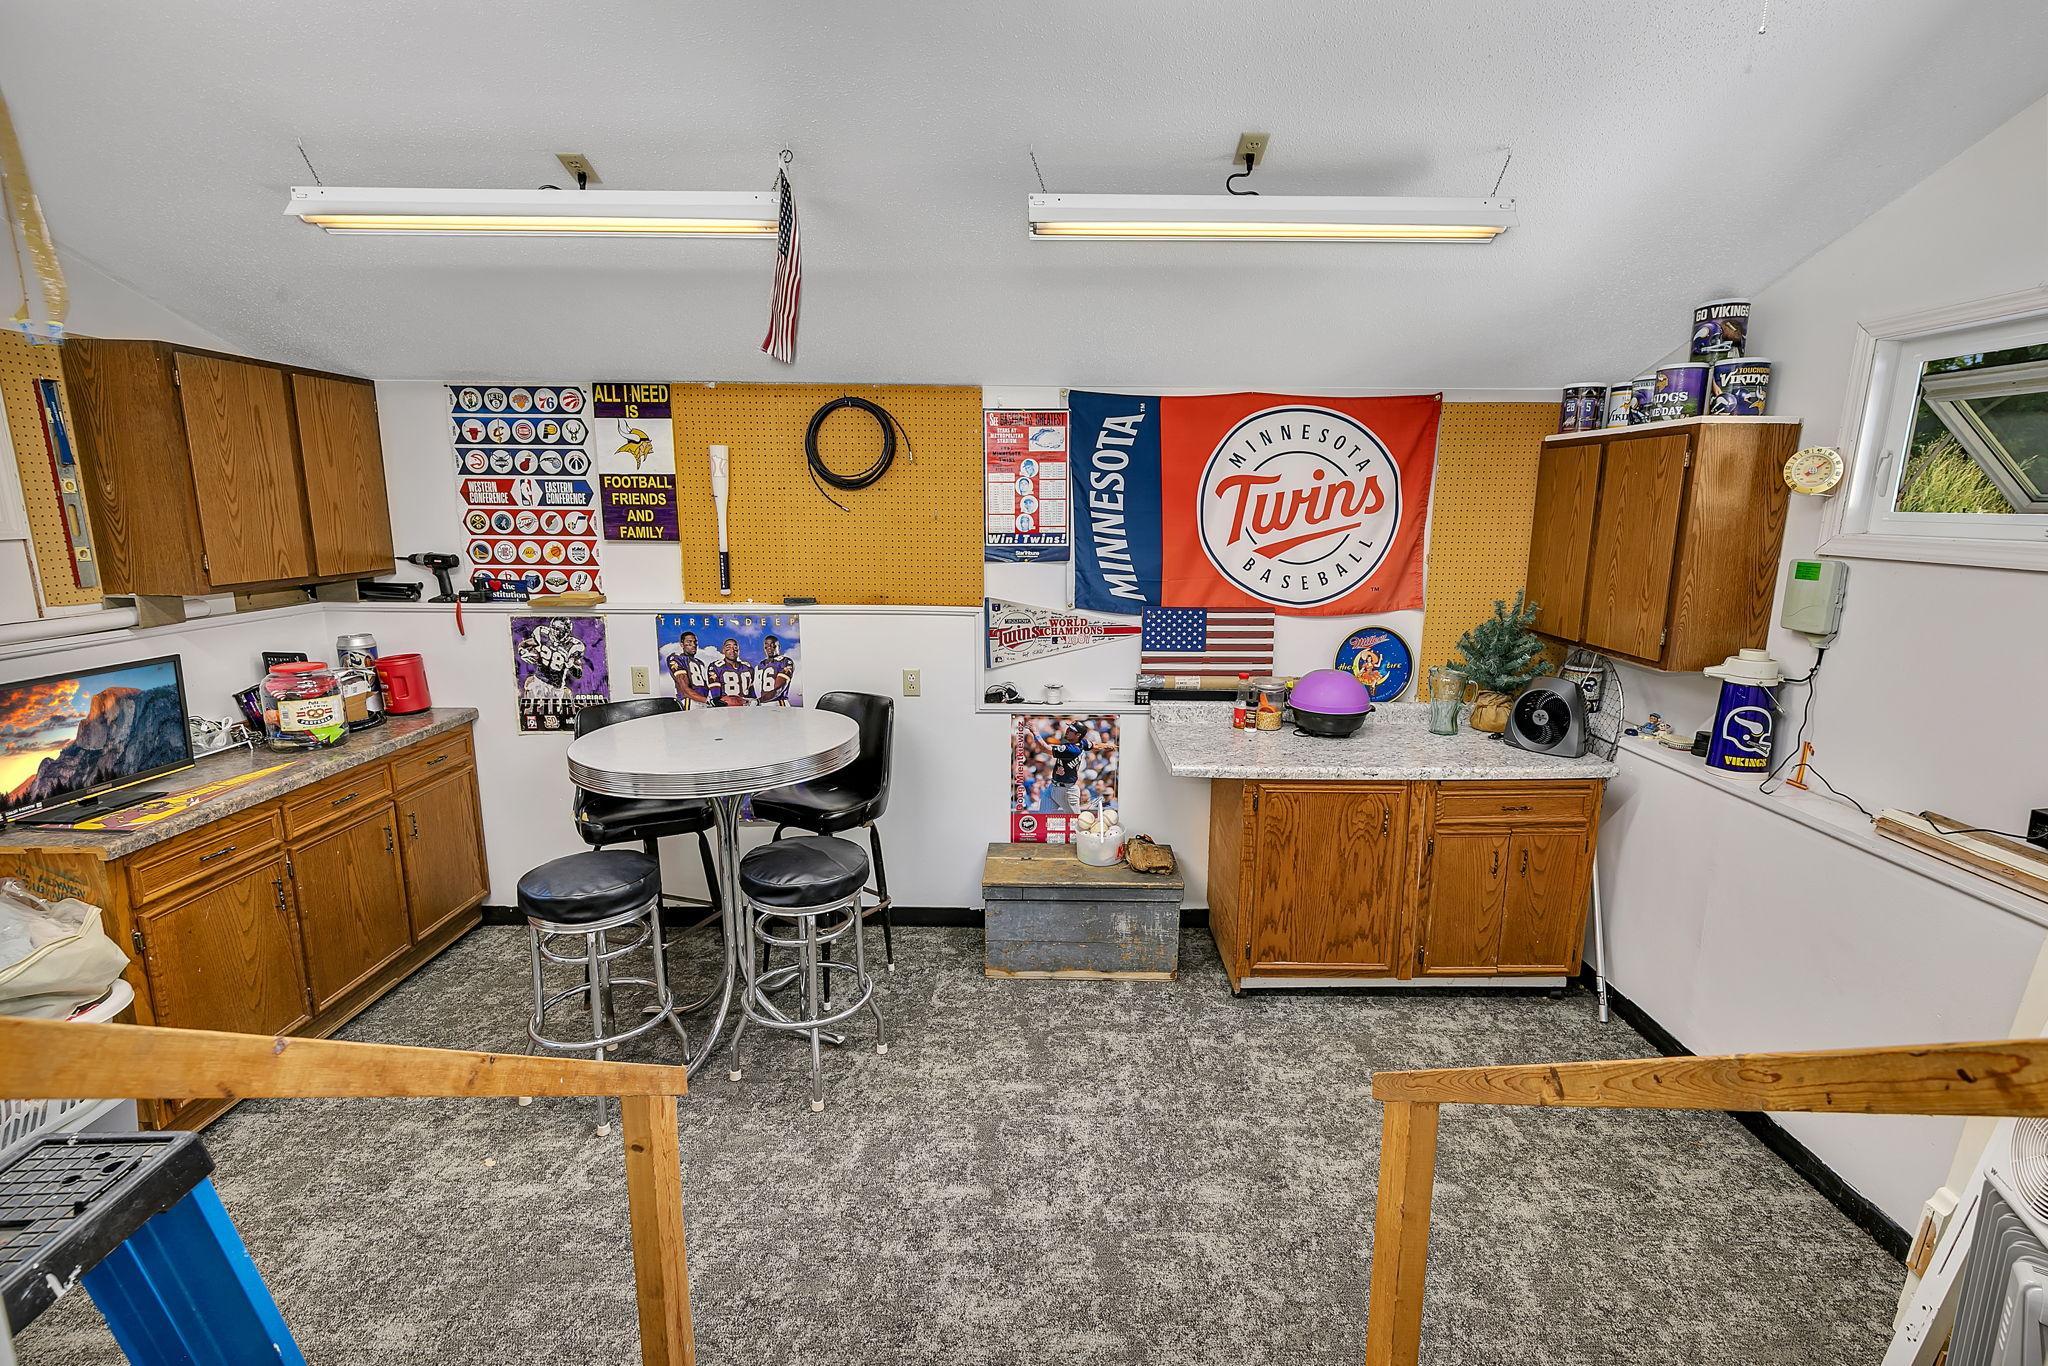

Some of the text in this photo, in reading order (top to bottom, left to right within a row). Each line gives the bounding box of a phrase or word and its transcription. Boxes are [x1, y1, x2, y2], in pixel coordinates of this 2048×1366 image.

[1695, 304, 1749, 321] GO VIKINGS
[594, 384, 669, 403] ALL I NEED
[539, 396, 555, 409] 76
[1566, 402, 1576, 412] 28
[1586, 402, 1592, 412] 5
[625, 404, 639, 418] IS
[1662, 406, 1684, 416] DAY
[1228, 424, 1372, 469] MINNESOTA
[467, 481, 498, 493] WESTERN
[544, 481, 574, 493] EASTERN
[603, 475, 672, 489] FOOTBALL
[469, 492, 510, 504] CONFERENCE
[545, 492, 587, 505] CONFERENCE
[611, 492, 667, 506] FRIENDS
[1089, 413, 1148, 602] MINNESOTA
[1214, 468, 1386, 548] Twins
[627, 509, 655, 522] AND
[619, 526, 664, 539] FAMILY
[988, 533, 1066, 544] Win! Twins!
[1242, 539, 1374, 591] BASEBALL
[502, 582, 516, 590] the
[492, 590, 527, 599] stitution
[660, 617, 796, 626] THREE DEEP
[1049, 618, 1088, 627] WORLD
[994, 624, 1040, 648] Twins
[1043, 626, 1104, 636] CHAMPIONS
[722, 670, 752, 697] 80
[1724, 755, 1767, 768] VIKINGS
[1015, 784, 1027, 812] Doug
